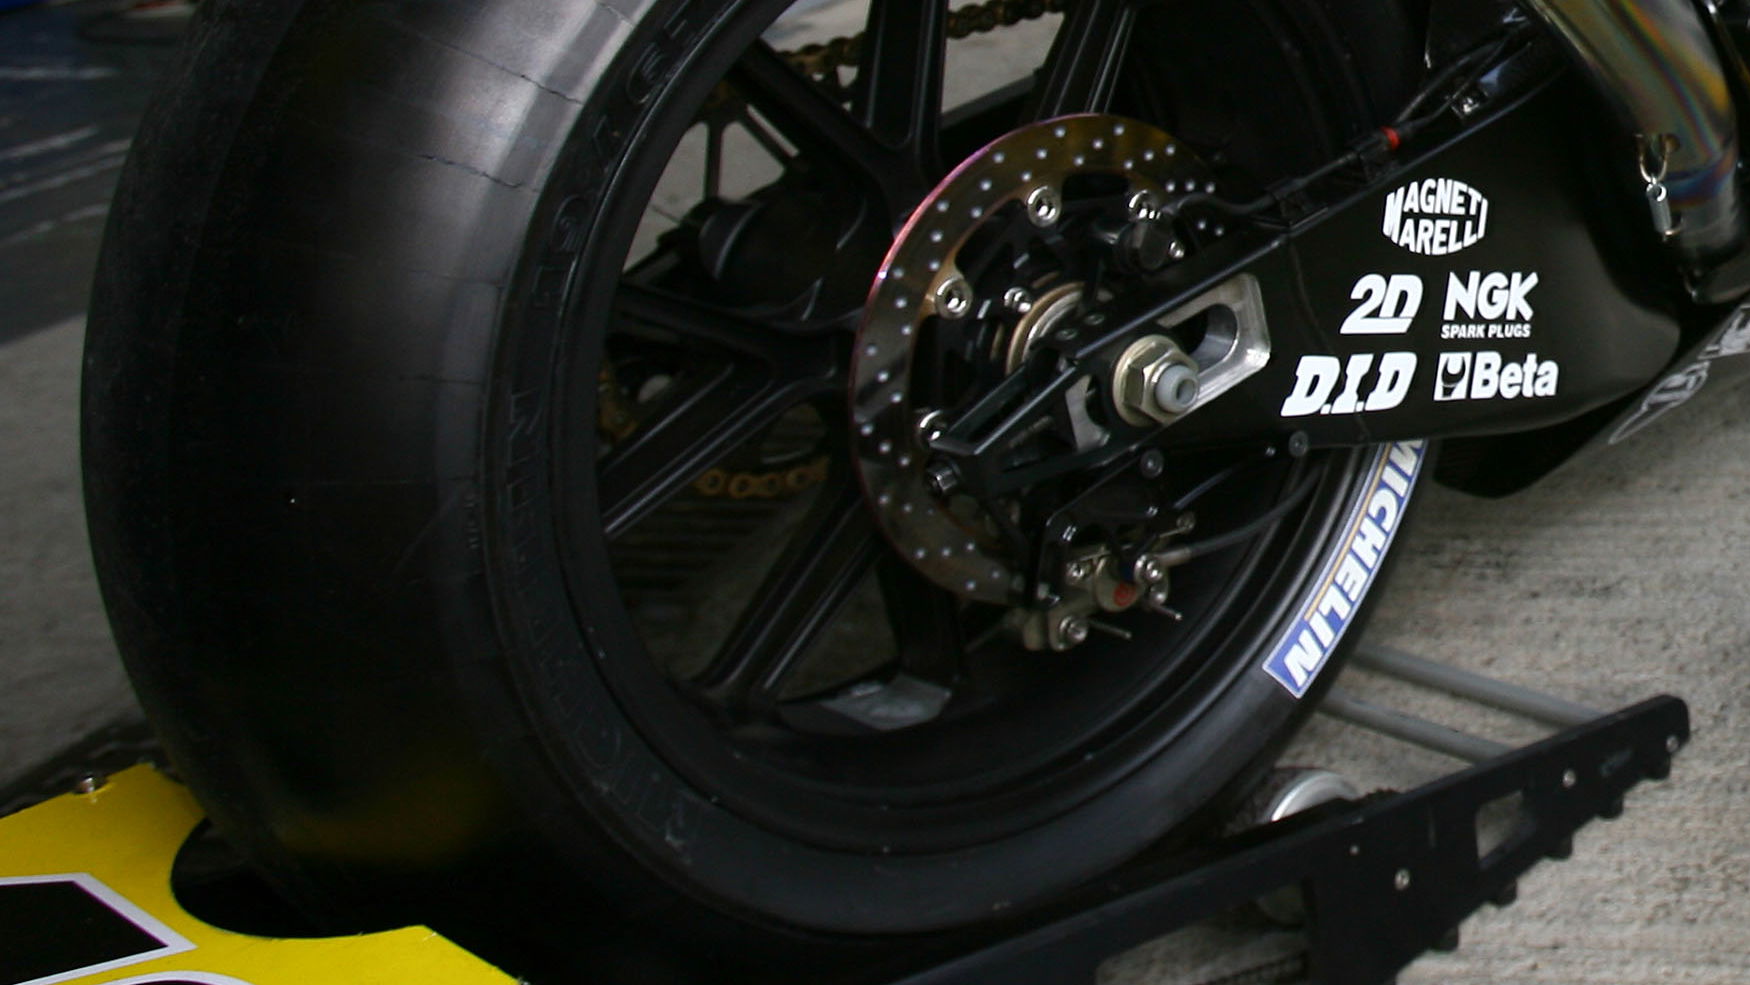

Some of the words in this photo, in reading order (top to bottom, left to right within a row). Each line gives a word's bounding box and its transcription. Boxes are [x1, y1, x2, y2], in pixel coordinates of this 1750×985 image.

[1383, 178, 1488, 225] MAGNETI
[1383, 211, 1488, 256] MARELLI
[1340, 274, 1424, 335] 2D
[1443, 270, 1539, 321] NGK
[1441, 324, 1486, 339] SPARK
[1488, 324, 1532, 338] PLUGS
[1281, 352, 1418, 417] D.I.D
[1470, 351, 1560, 400] Beta
[1283, 439, 1425, 688] MICHELIN
